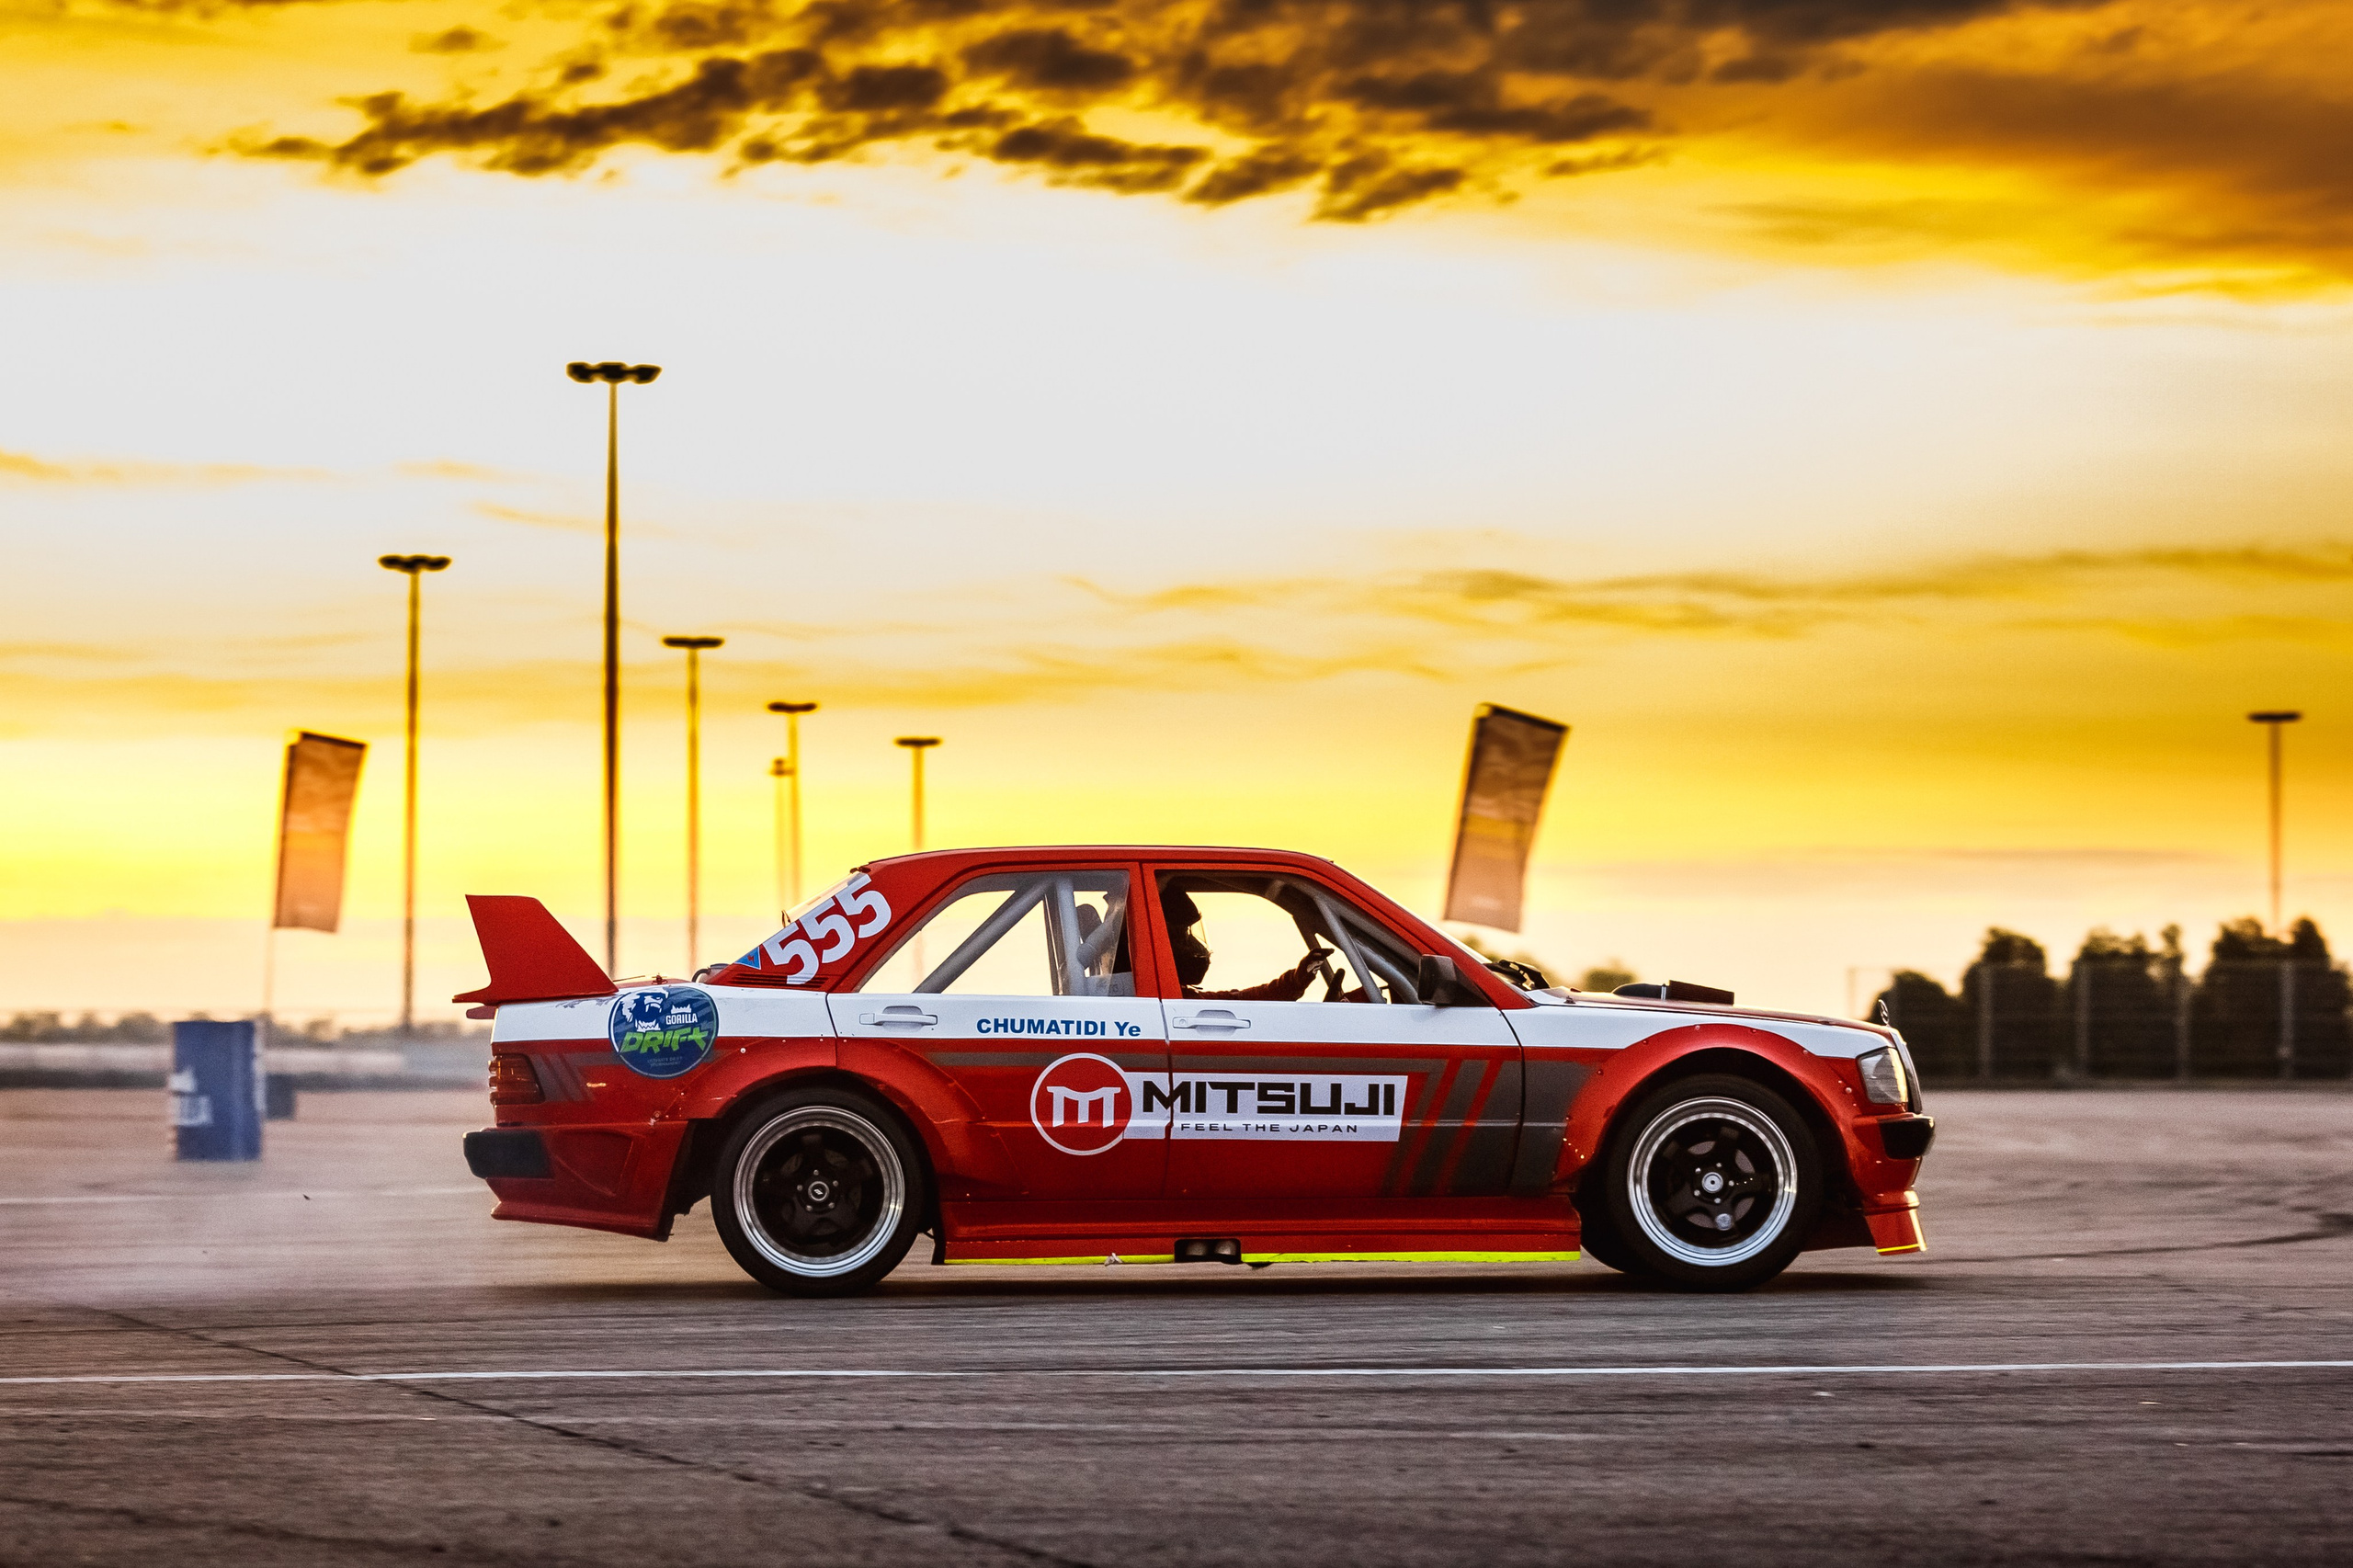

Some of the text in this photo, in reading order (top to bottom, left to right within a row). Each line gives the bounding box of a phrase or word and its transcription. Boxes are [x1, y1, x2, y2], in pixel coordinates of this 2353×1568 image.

[762, 873, 892, 985] 555
[665, 1013, 698, 1025] GORILLA
[976, 1017, 1142, 1037] CHUMATIDI Ye
[620, 1027, 709, 1054] DRIFT
[1142, 1080, 1395, 1116] MITSUJI
[1180, 1123, 1358, 1133] FEEL THE JAPAN
